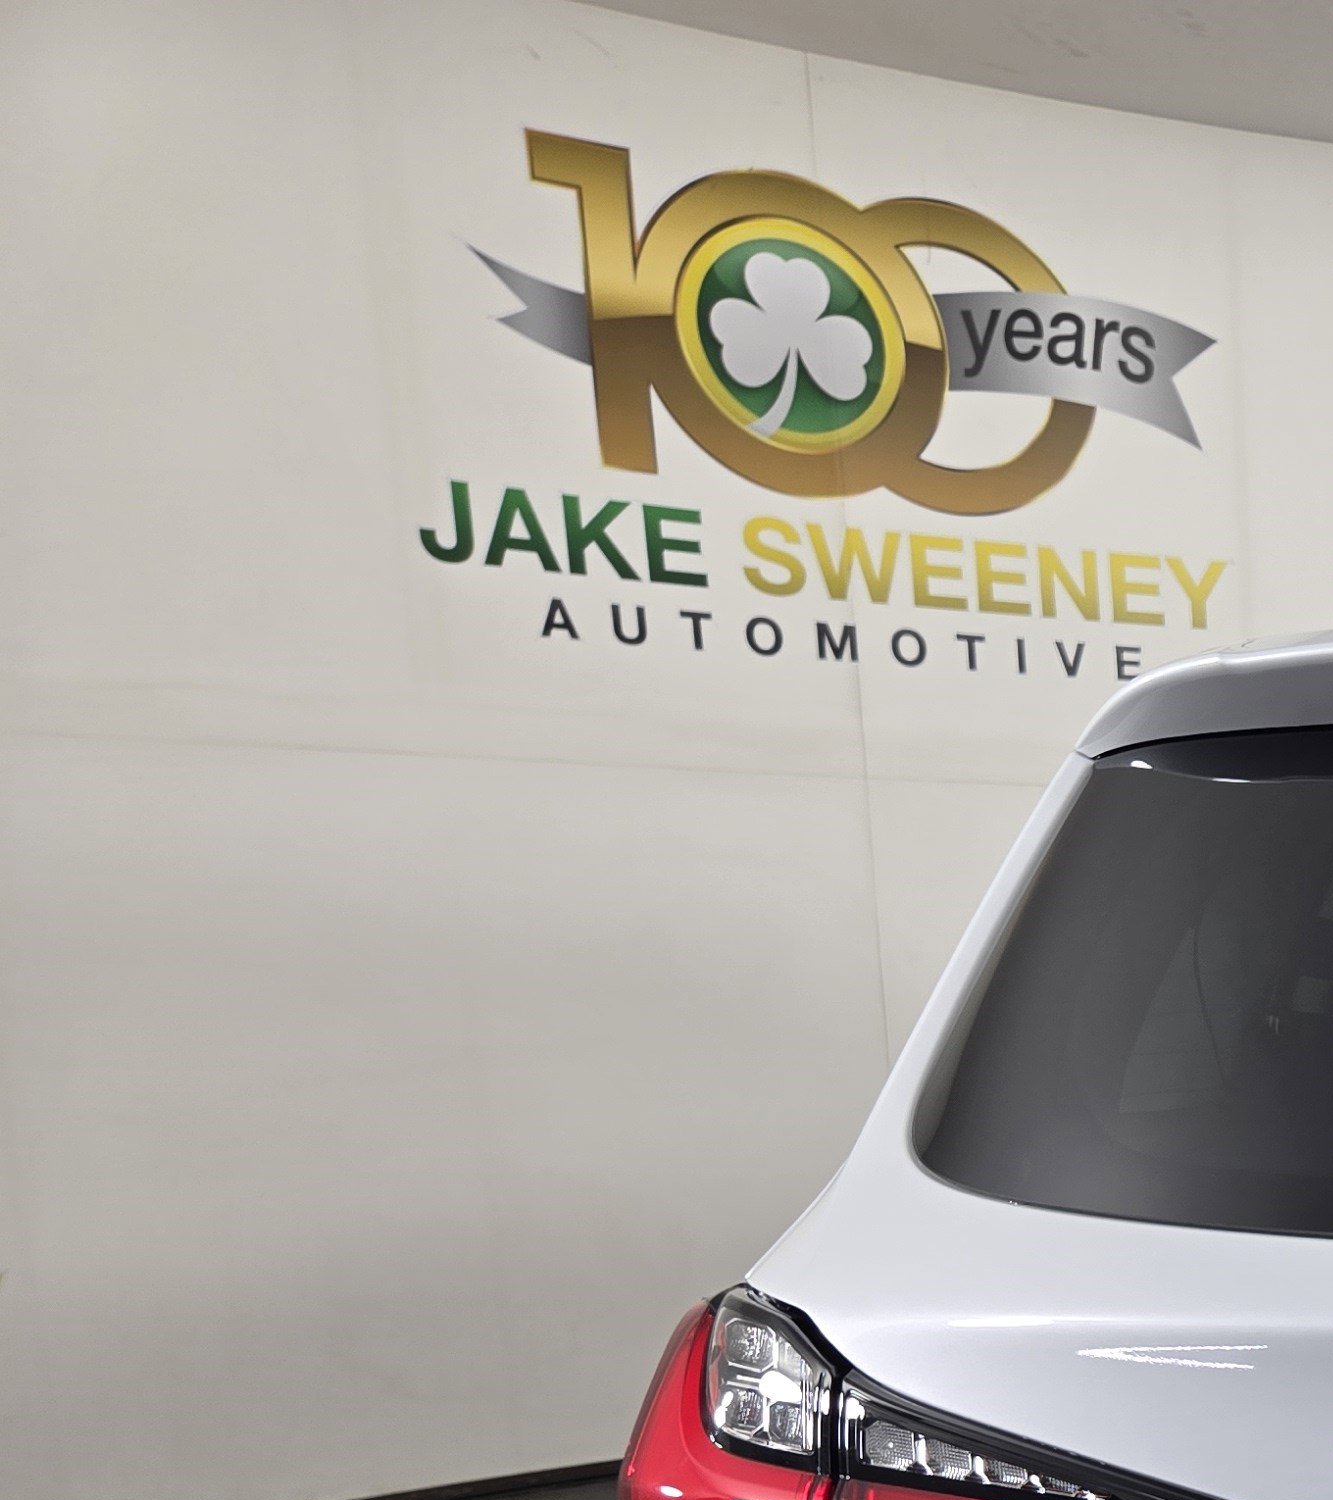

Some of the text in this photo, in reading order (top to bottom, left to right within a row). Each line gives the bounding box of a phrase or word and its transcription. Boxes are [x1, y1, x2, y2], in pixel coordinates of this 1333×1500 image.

[961, 303, 1157, 384] years
[419, 480, 1229, 630] JAKE SWEENEY
[540, 598, 1142, 681] AUTOMOTIVE
